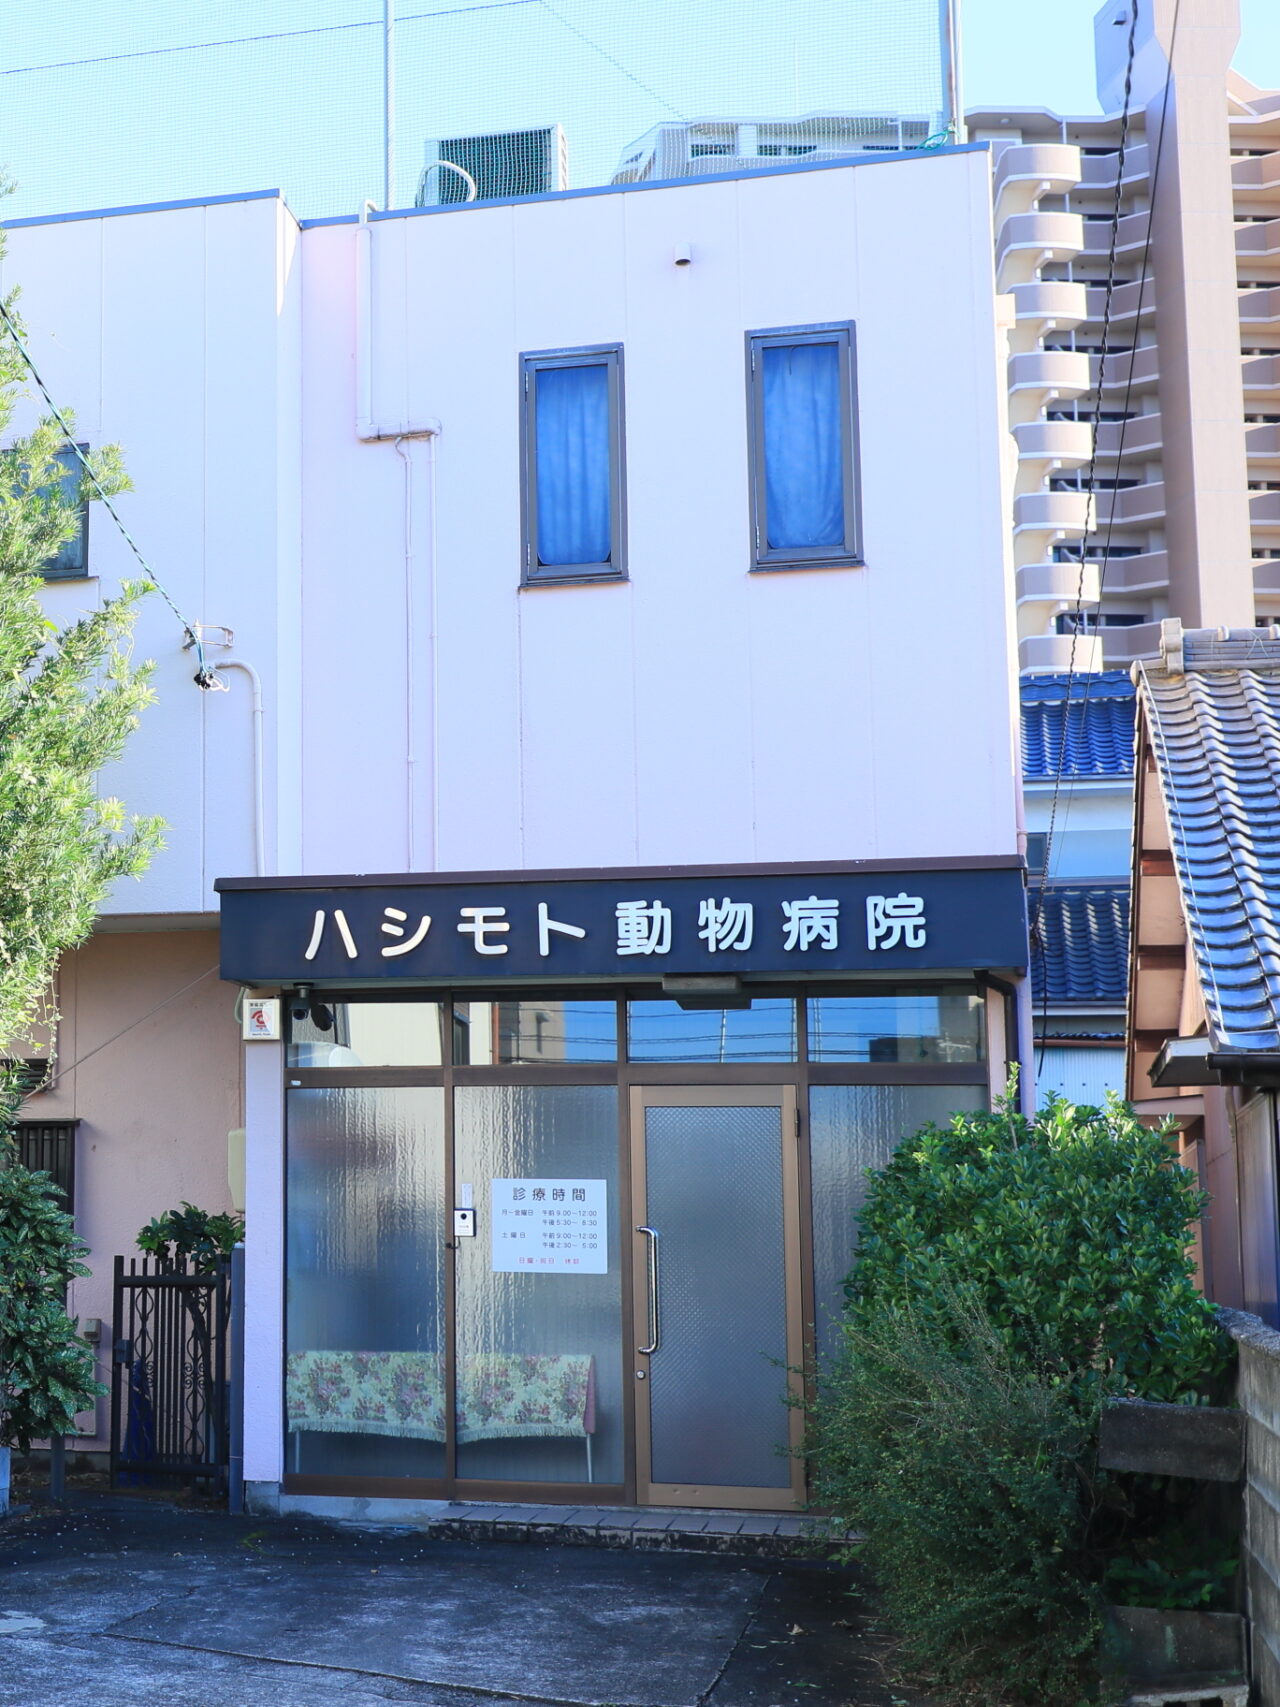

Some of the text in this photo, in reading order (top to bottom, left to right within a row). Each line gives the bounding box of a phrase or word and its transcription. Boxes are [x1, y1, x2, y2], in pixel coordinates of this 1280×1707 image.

[304, 893, 927, 960] ハシモト動物病院
[513, 1187, 586, 1202] 診療時間
